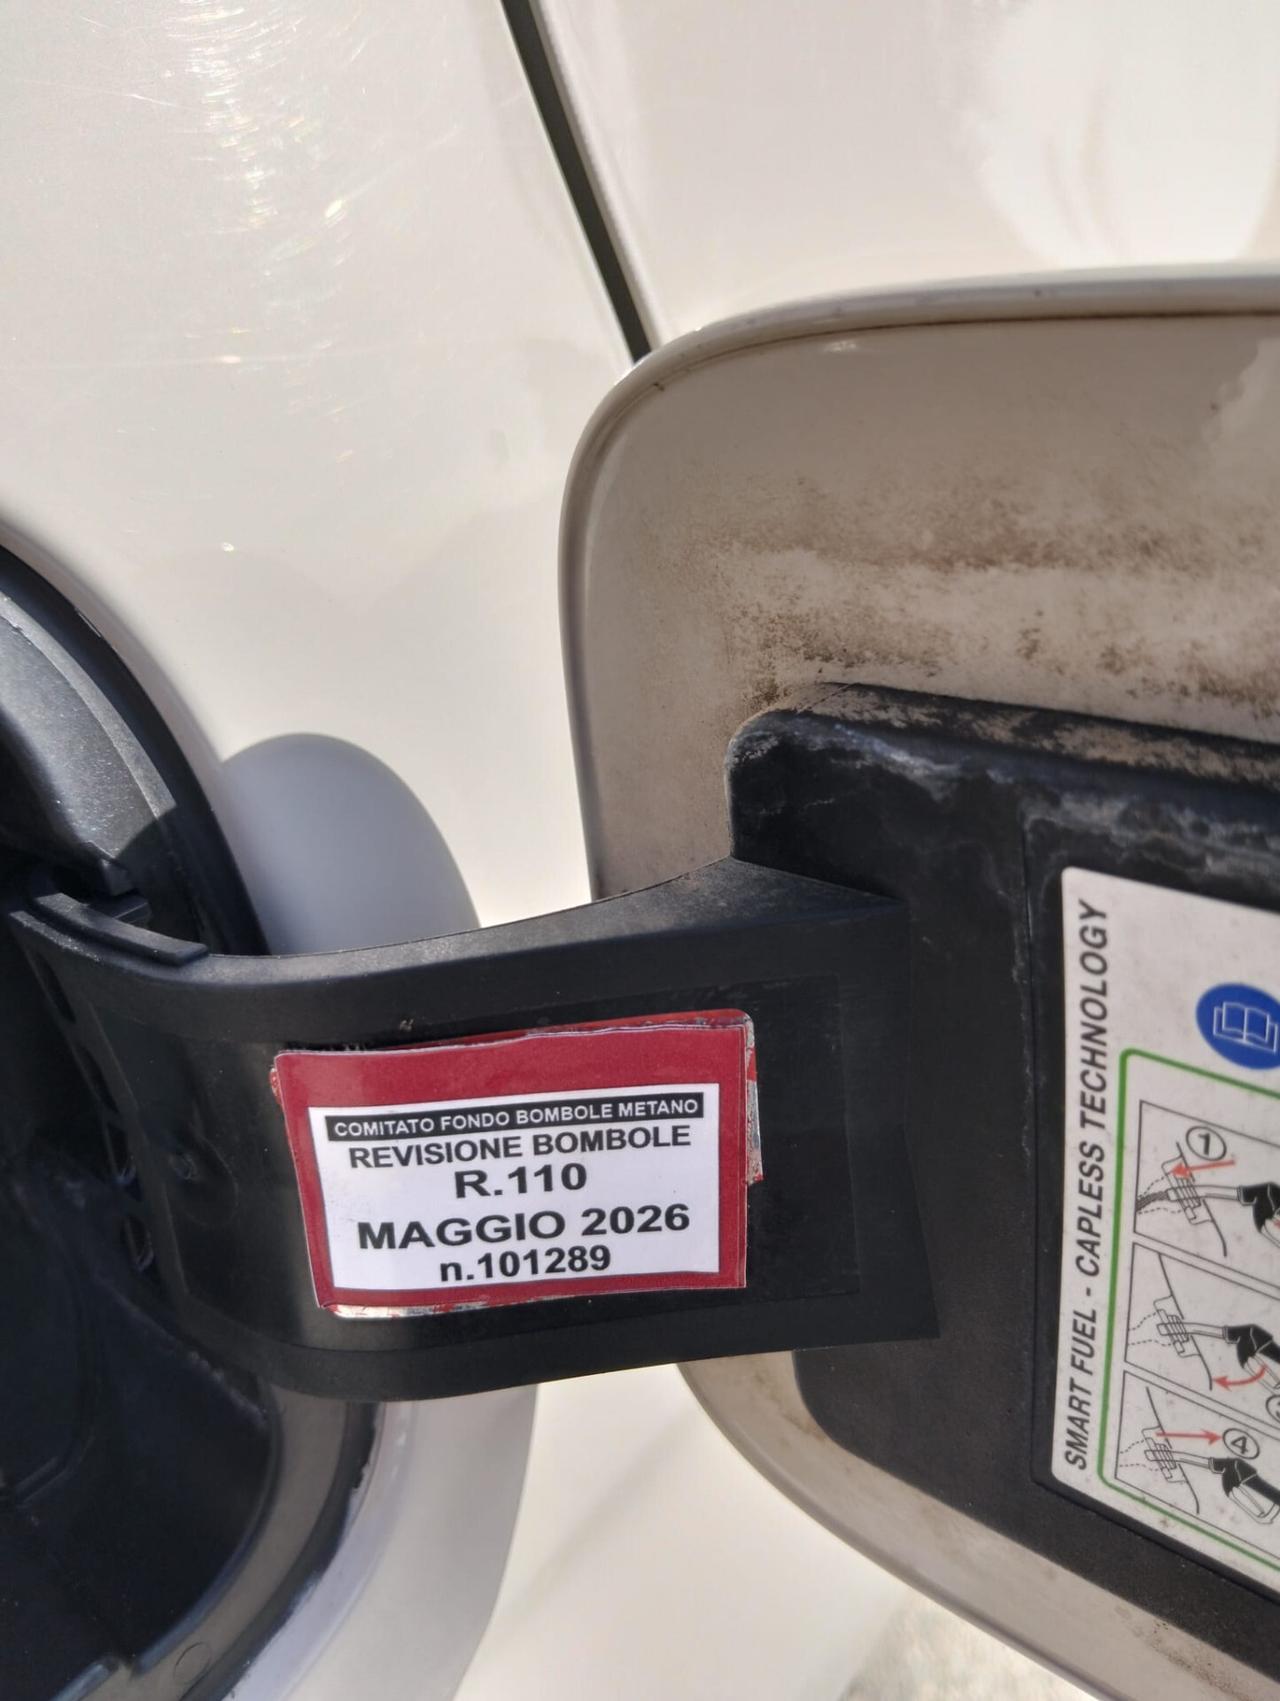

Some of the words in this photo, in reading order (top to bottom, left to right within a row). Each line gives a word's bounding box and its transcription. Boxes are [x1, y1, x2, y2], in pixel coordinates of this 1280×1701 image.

[1079, 899, 1108, 1129] TECHNOLOGY
[334, 1116, 435, 1137] COMITATO
[440, 1110, 510, 1131] FONDO
[516, 1103, 613, 1125] BOMBOLE
[618, 1099, 699, 1118] METANO
[349, 1136, 522, 1168] REVISIONE
[533, 1125, 691, 1156] BOMBOLE
[455, 1162, 587, 1198] R.110
[358, 1210, 566, 1249] MAGGIO
[582, 1203, 690, 1236] 2026
[1075, 1141, 1105, 1277] CAPLESS
[440, 1244, 611, 1281] n.101289
[1070, 1307, 1097, 1375] FUEL
[1065, 1378, 1093, 1470] SMART
[1230, 1434, 1249, 1455] 4
